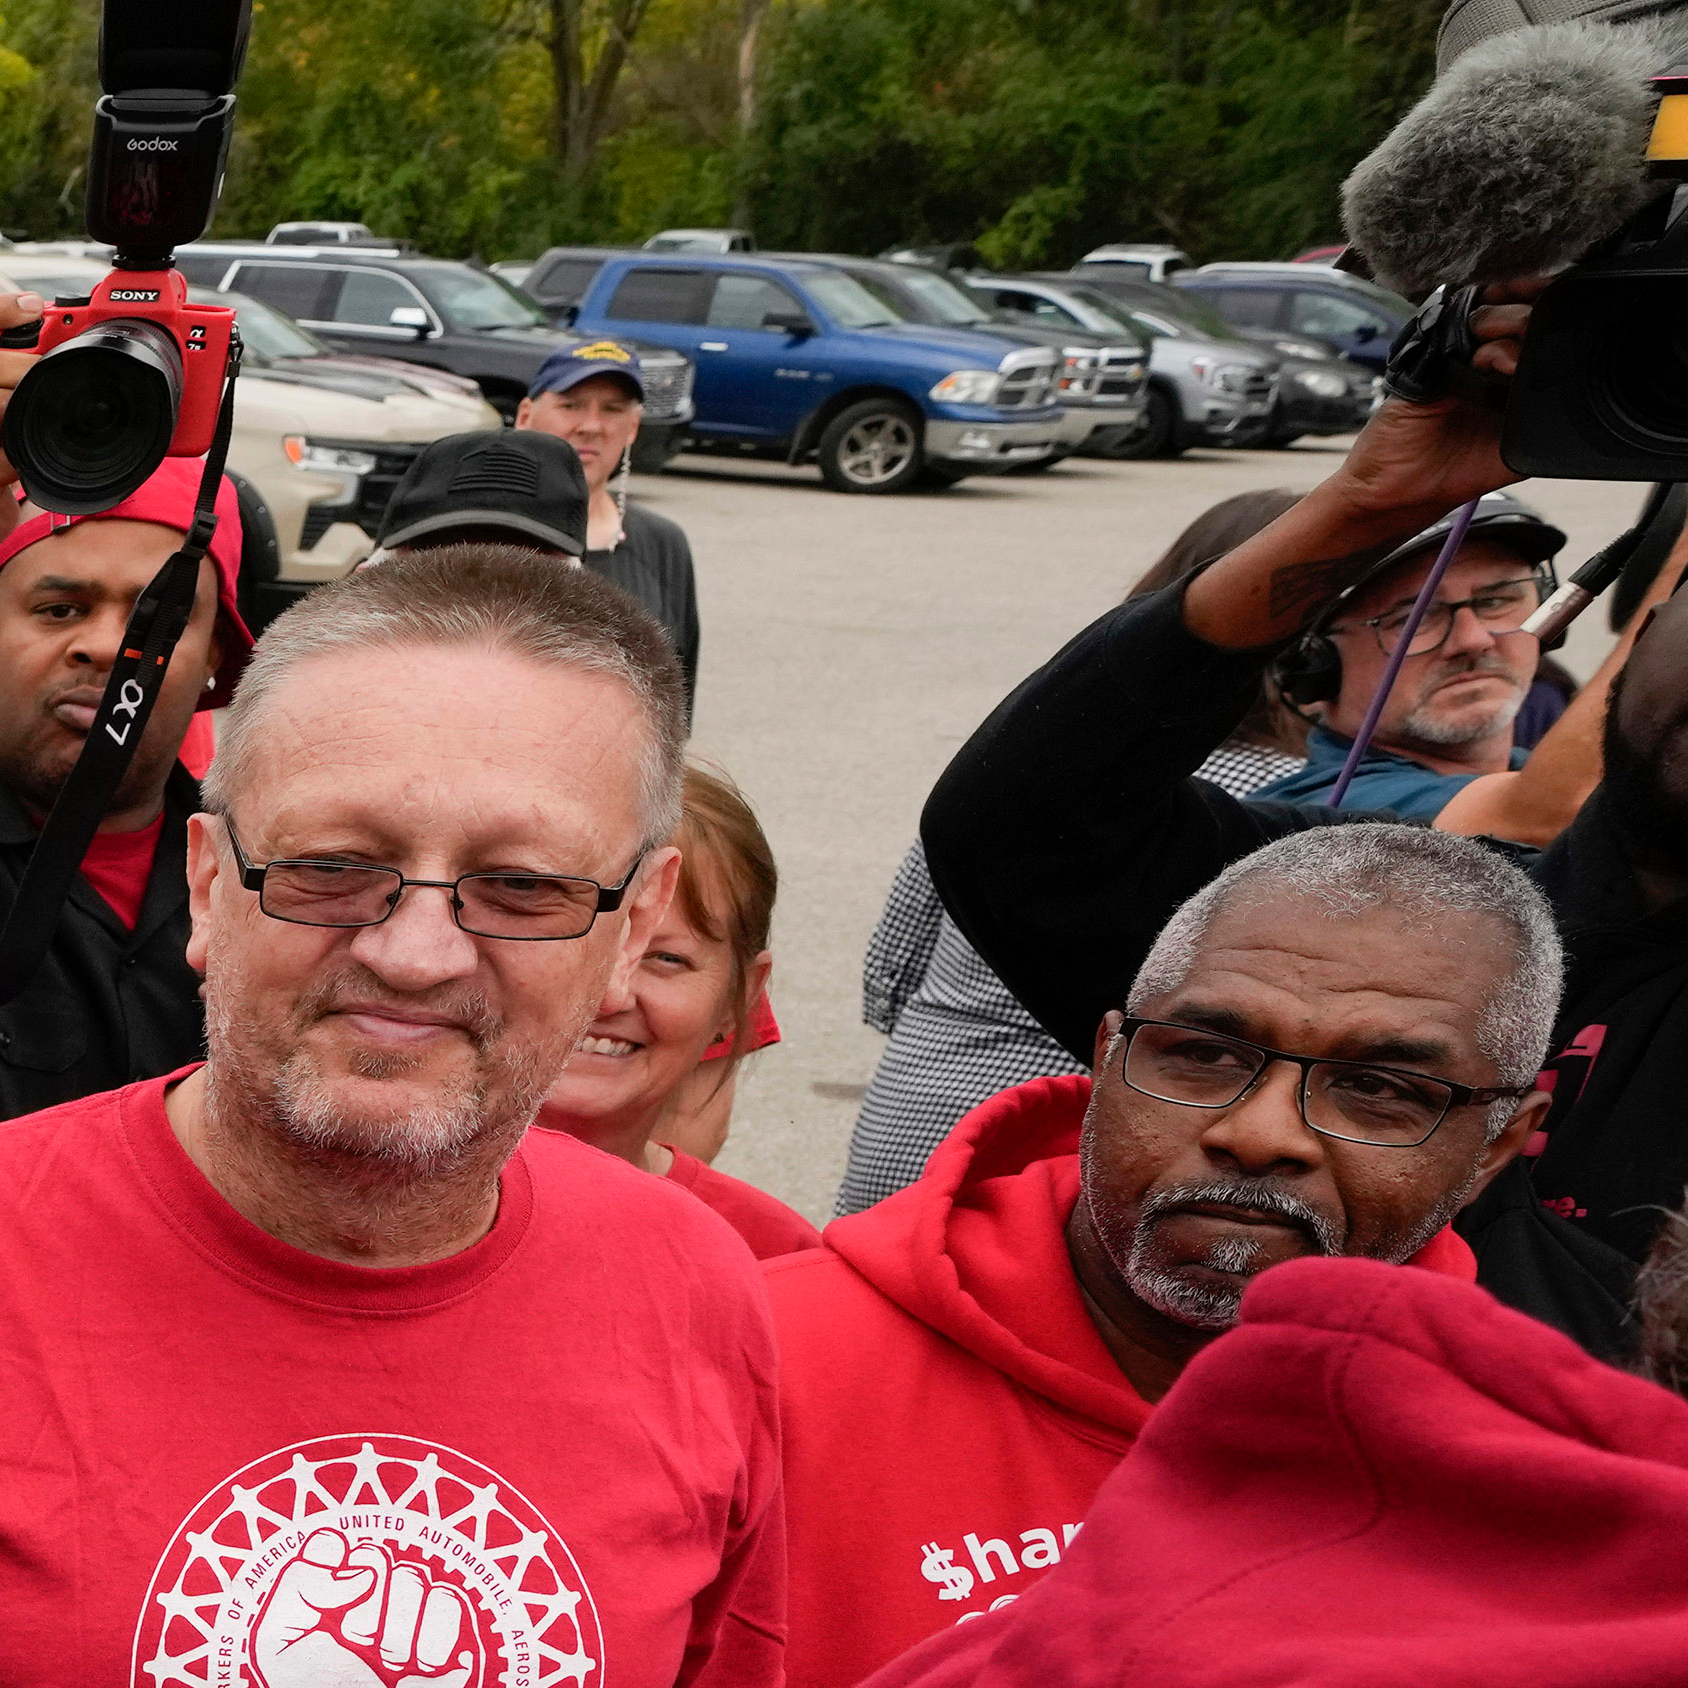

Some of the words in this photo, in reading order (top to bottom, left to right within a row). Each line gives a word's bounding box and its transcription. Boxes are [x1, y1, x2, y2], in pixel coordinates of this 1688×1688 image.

[127, 136, 178, 151] Godox
[110, 290, 159, 301] SONY
[339, 1514, 405, 1532] UNITED
[227, 1597, 245, 1621] OF
[245, 1529, 307, 1590] AMERICA
